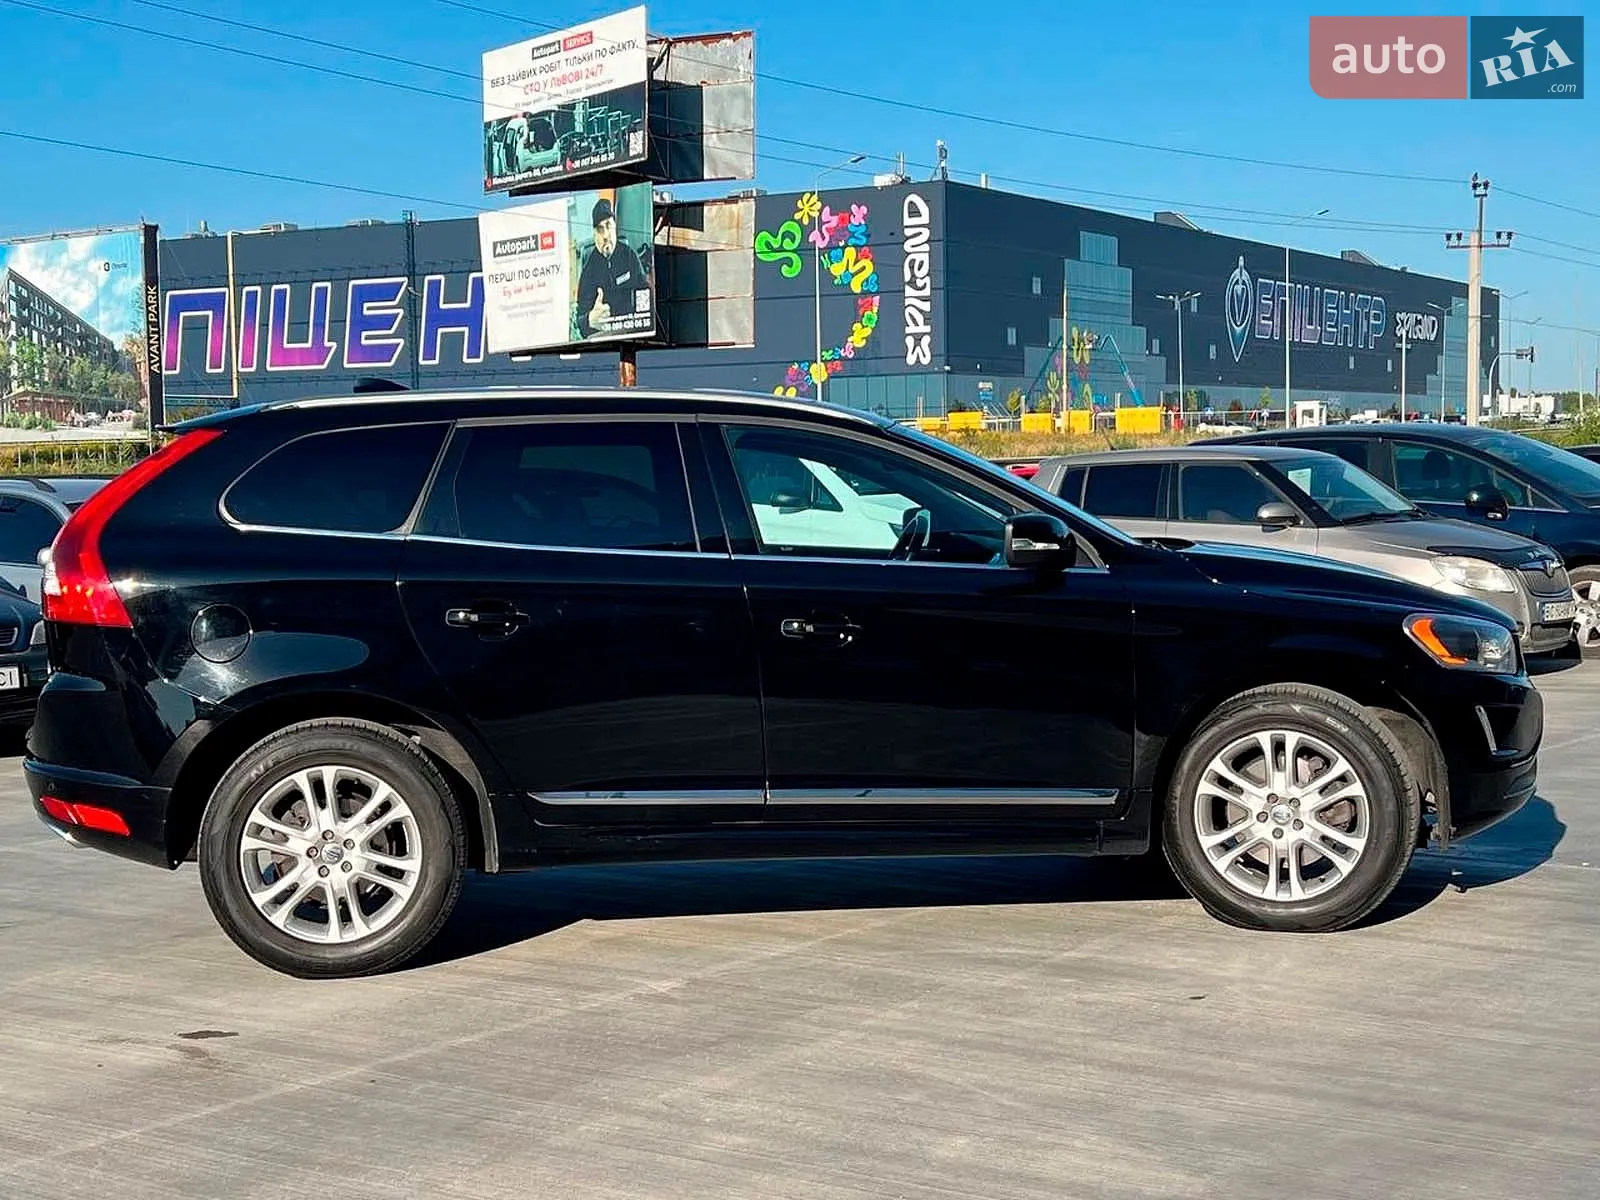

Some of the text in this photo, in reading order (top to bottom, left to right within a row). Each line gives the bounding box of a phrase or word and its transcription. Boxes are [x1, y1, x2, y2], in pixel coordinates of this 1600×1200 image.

[594, 49, 608, 62] ПО
[550, 71, 583, 89] ЛЬВОВІ
[495, 237, 537, 256] Autopark
[488, 263, 561, 285] ПЕРШІ ПО ФАКТУ
[1255, 278, 1387, 350] ЕПІЦЕНТР
[147, 285, 160, 373] AVANT PARK
